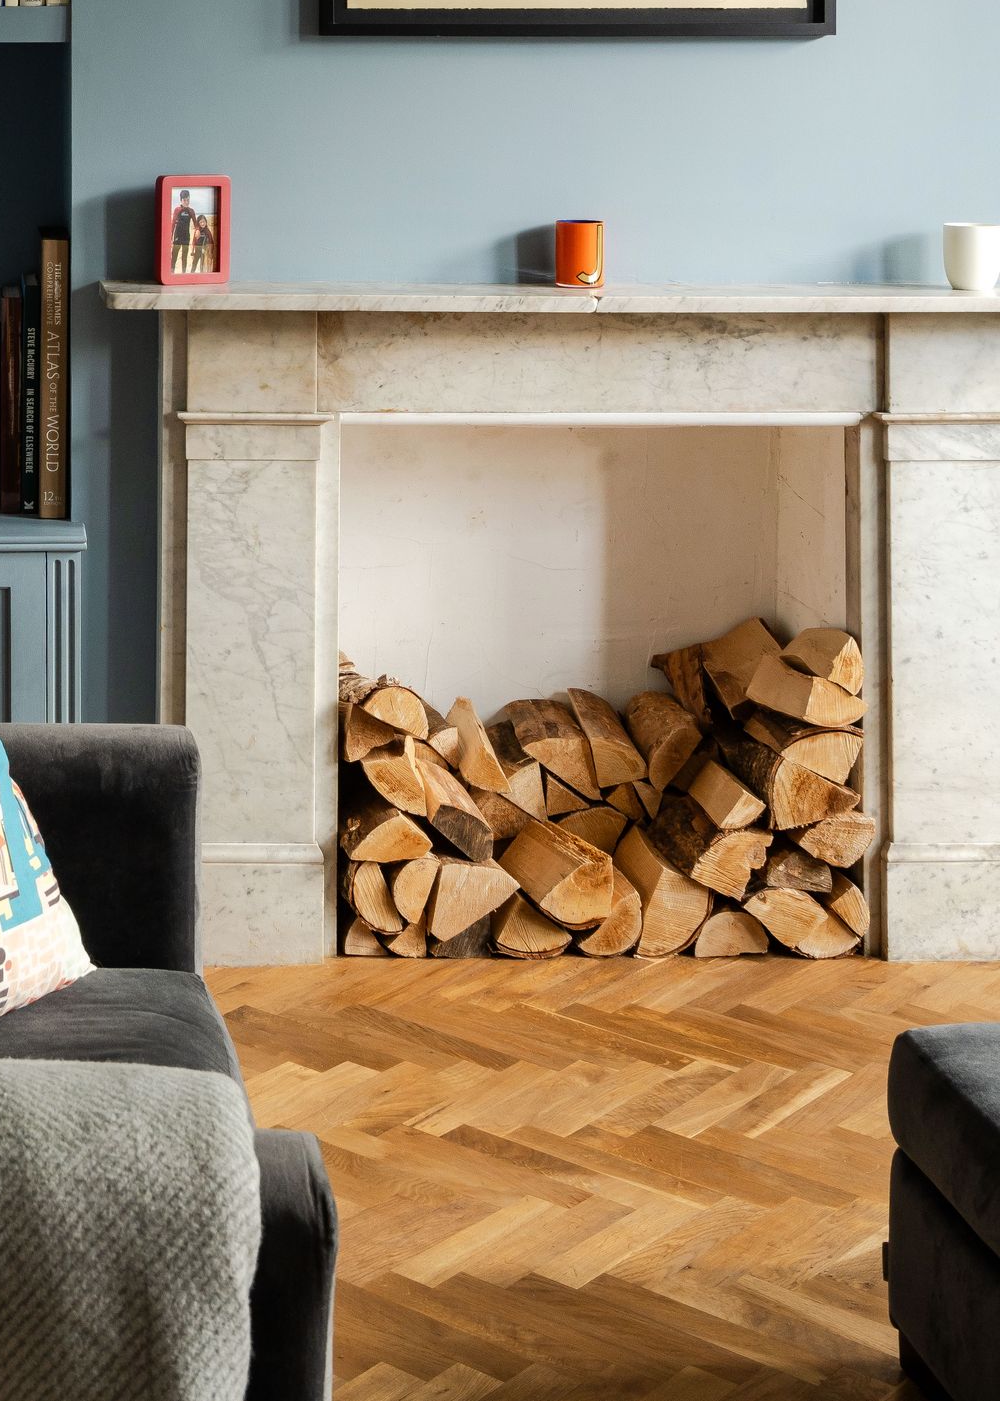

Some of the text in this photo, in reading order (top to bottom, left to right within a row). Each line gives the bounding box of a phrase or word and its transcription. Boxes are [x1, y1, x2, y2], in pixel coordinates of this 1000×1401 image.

[46, 261, 54, 327] COMPREHENSIVE
[54, 262, 62, 326] THE TIMES
[25, 327, 36, 474] STEVE McCURRY IN SEARCH OF ELSEWHERE
[45, 330, 61, 473] ATLAS OF THE WORLD
